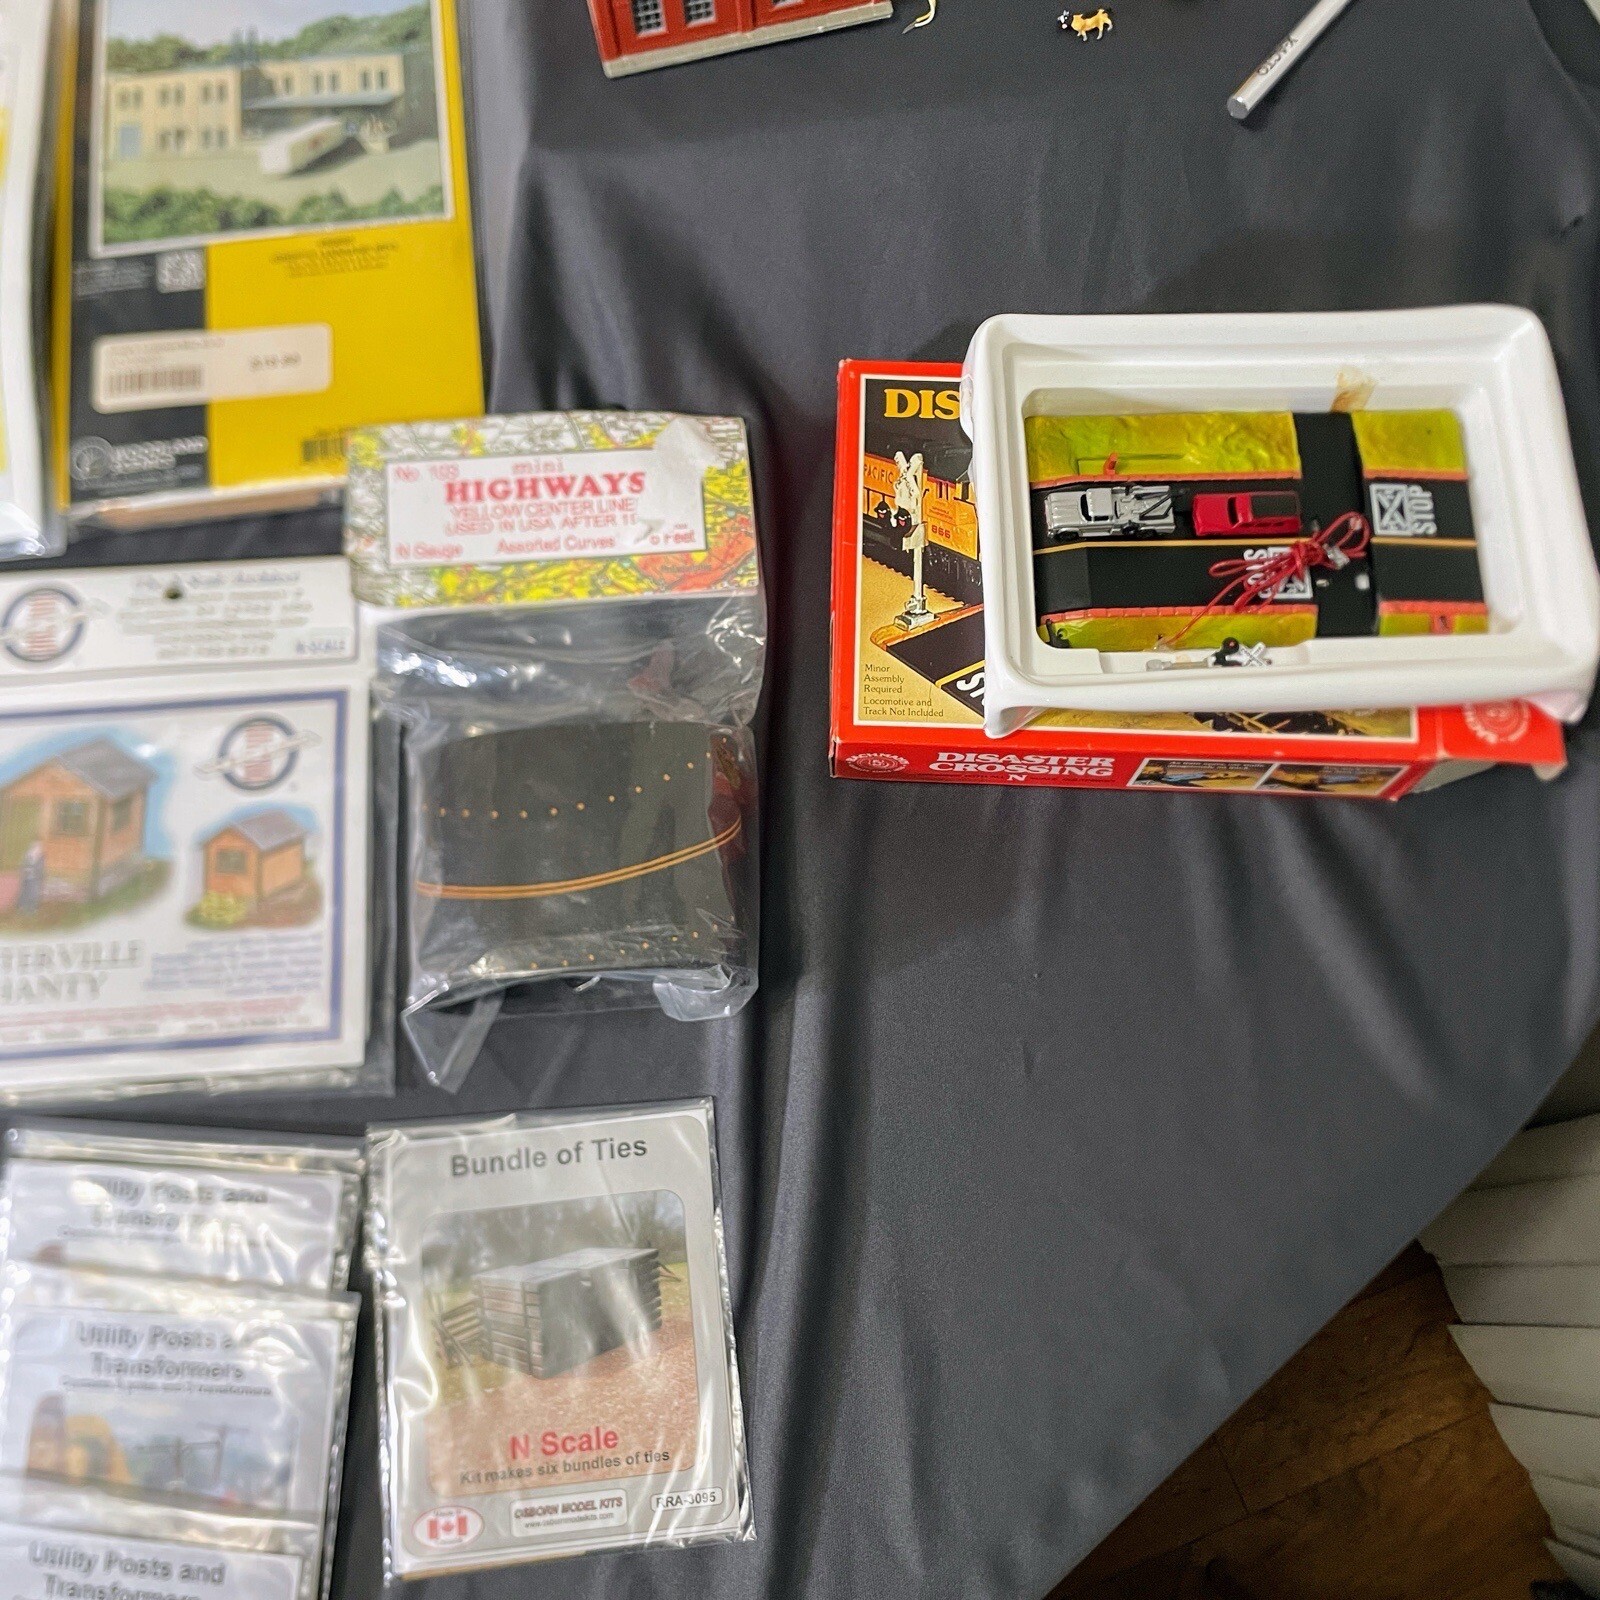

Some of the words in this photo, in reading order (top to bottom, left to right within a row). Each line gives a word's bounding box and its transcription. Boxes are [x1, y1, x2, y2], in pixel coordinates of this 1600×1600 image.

[512, 459, 563, 473] mini
[446, 472, 645, 503] HIGHWAYS
[597, 498, 635, 513] LINE
[1407, 484, 1437, 536] STOP
[518, 516, 555, 532] USA
[562, 514, 617, 529] AFTER
[497, 536, 561, 555] Assorted
[564, 534, 616, 551] Curves
[864, 664, 891, 673] Minor
[863, 674, 905, 684] Assembly
[863, 685, 903, 694] Required
[863, 696, 914, 706] Locomotive
[916, 699, 932, 707] and
[863, 707, 887, 716] Track
[889, 707, 906, 716] Not
[908, 708, 944, 717] Included
[936, 752, 1115, 767] DISASTER
[928, 762, 1114, 777] CROSSING
[1007, 774, 1028, 782] N
[452, 1147, 547, 1177] Bundle
[557, 1141, 584, 1165] of
[591, 1137, 648, 1161] Ties
[150, 1325, 216, 1350] Posts
[91, 1351, 244, 1380] Transformers
[509, 1434, 530, 1460] N
[541, 1426, 619, 1456] Scale
[459, 1470, 482, 1486] Kit
[484, 1466, 532, 1482] makes
[537, 1463, 559, 1476] six
[563, 1456, 621, 1472] bundles
[626, 1452, 641, 1466] of
[644, 1450, 670, 1464] ties
[600, 1496, 623, 1509] KITS
[29, 1540, 97, 1576] Utility
[103, 1550, 173, 1580] Posts
[179, 1562, 225, 1585] and
